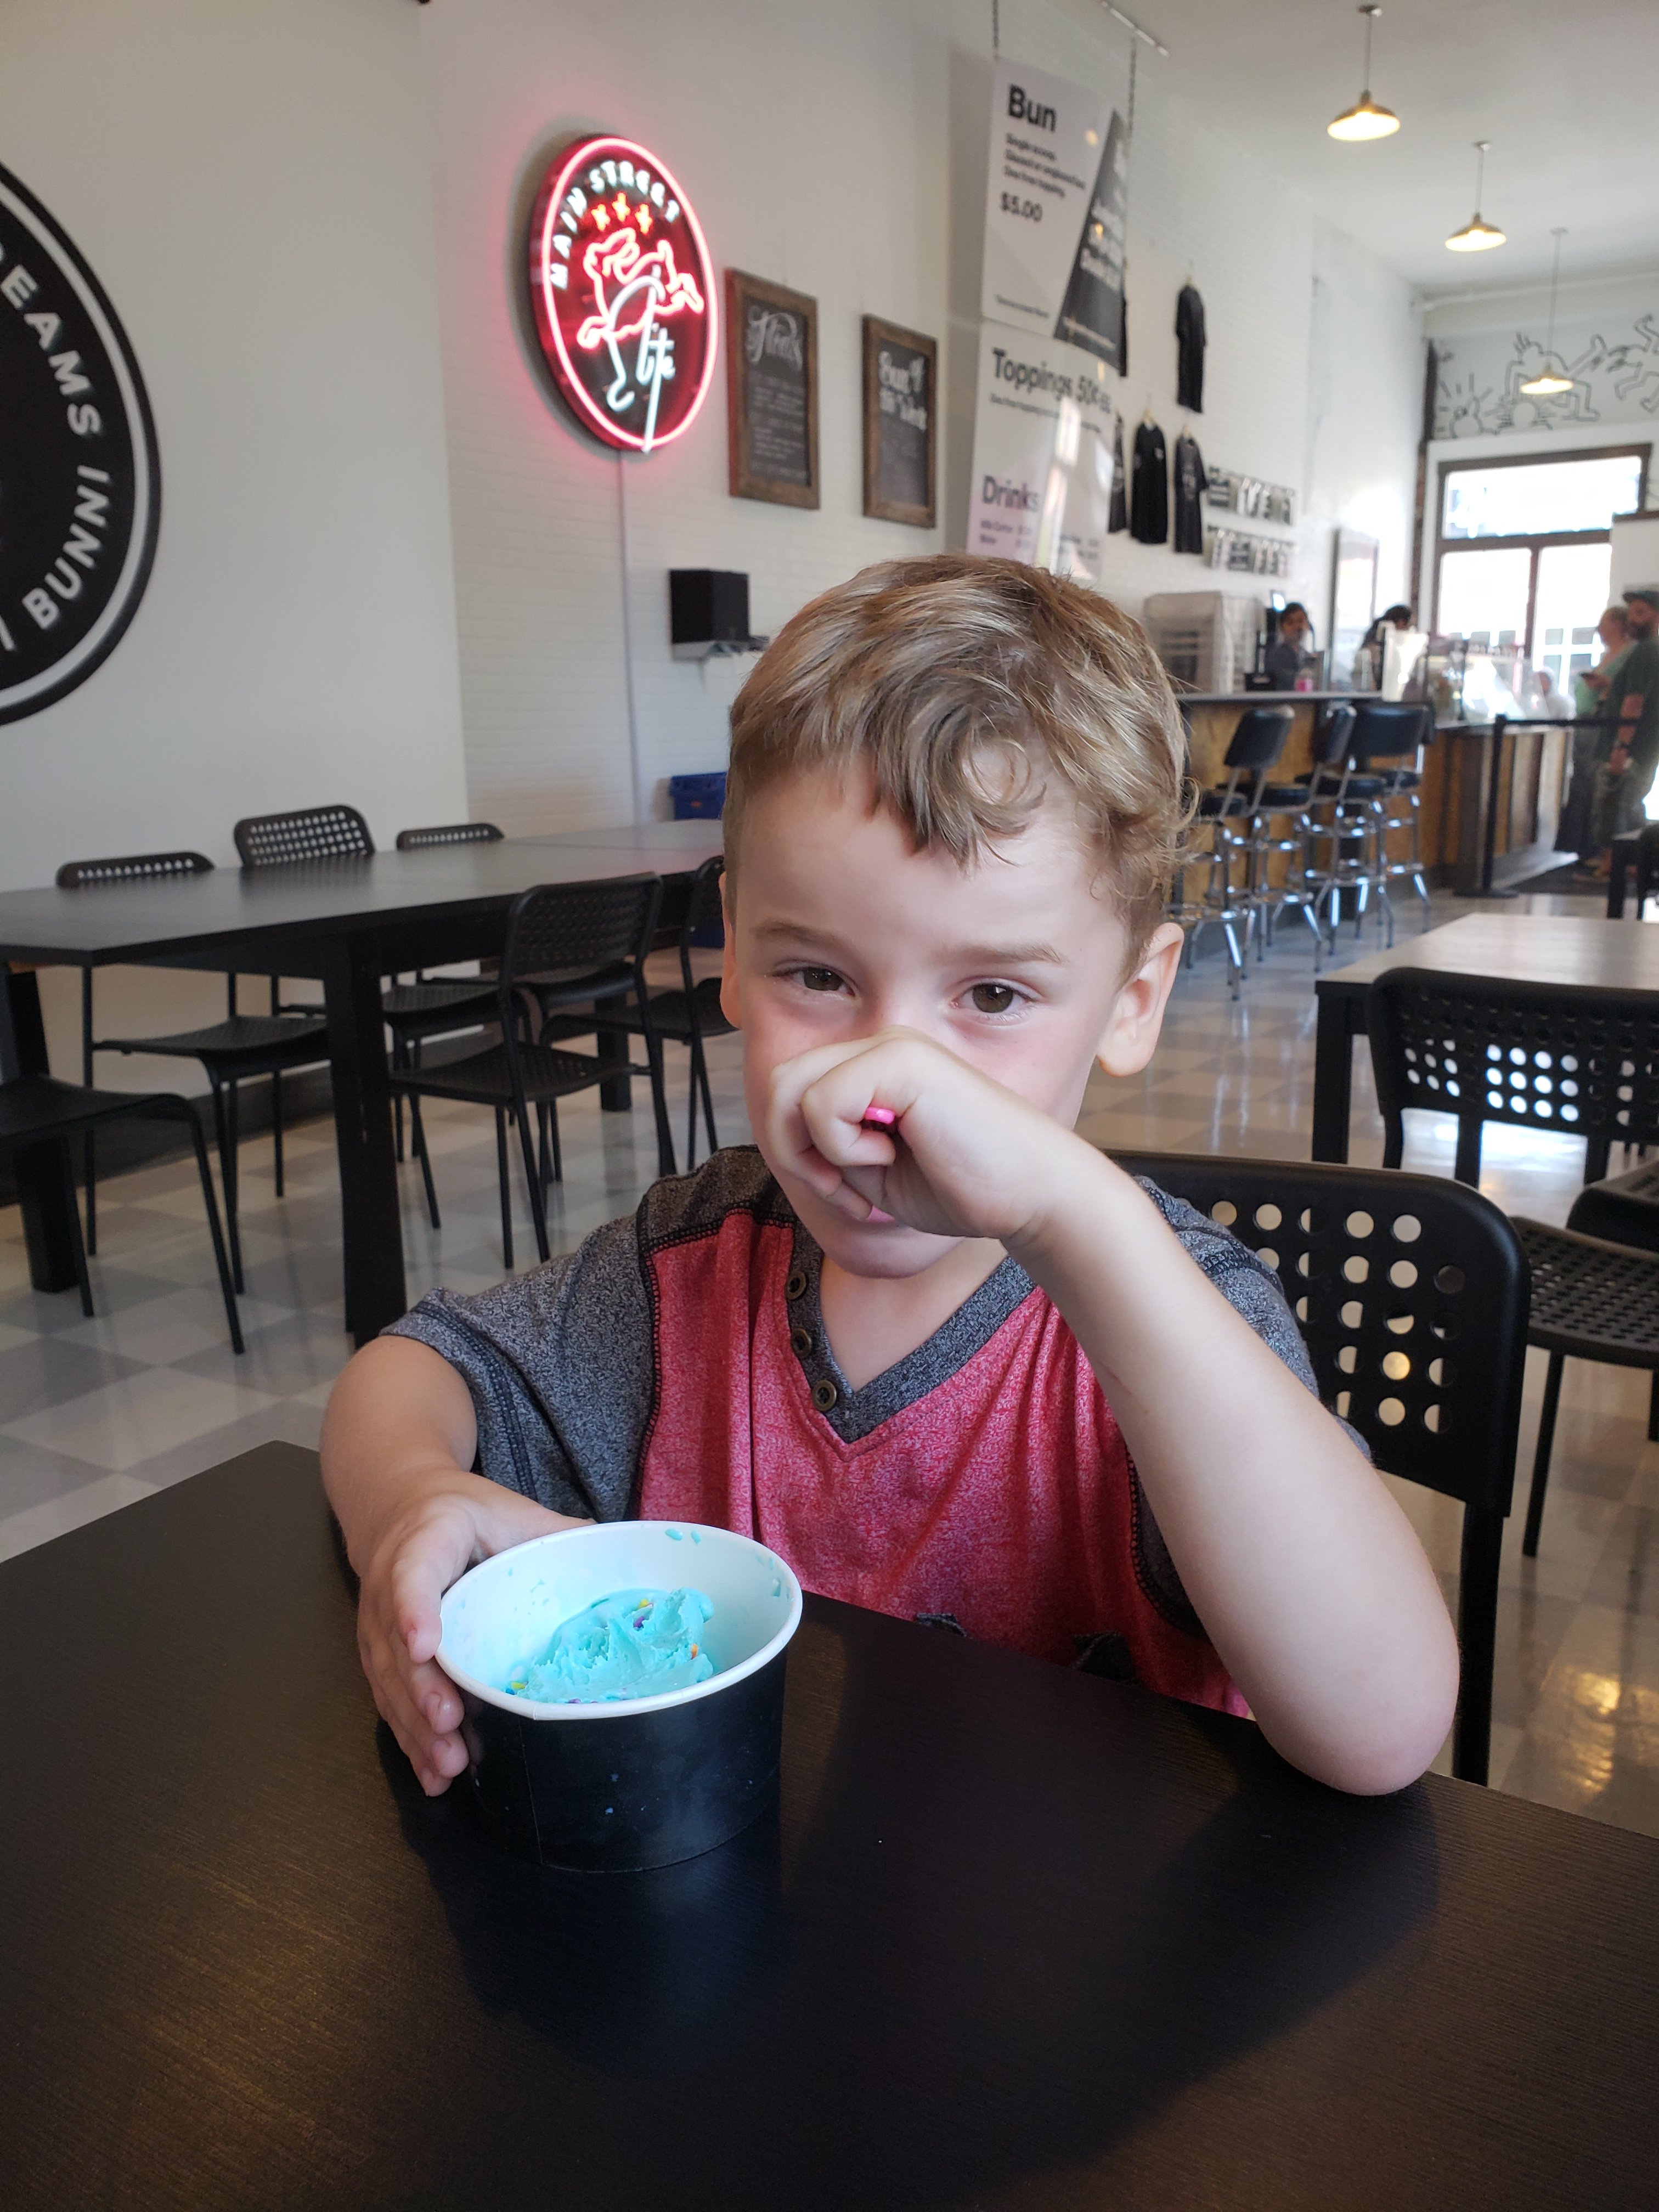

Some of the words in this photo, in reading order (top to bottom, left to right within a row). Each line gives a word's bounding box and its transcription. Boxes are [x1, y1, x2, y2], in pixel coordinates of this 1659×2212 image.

[1008, 82, 1056, 132] Bun
[549, 185, 588, 290] MAIN
[589, 160, 680, 223] STREET
[1001, 191, 1042, 223] $5.00
[0, 241, 103, 437] EAMS
[994, 346, 1073, 402] Toppings
[982, 474, 1039, 512] Drinks
[21, 465, 110, 630] BUNNI
